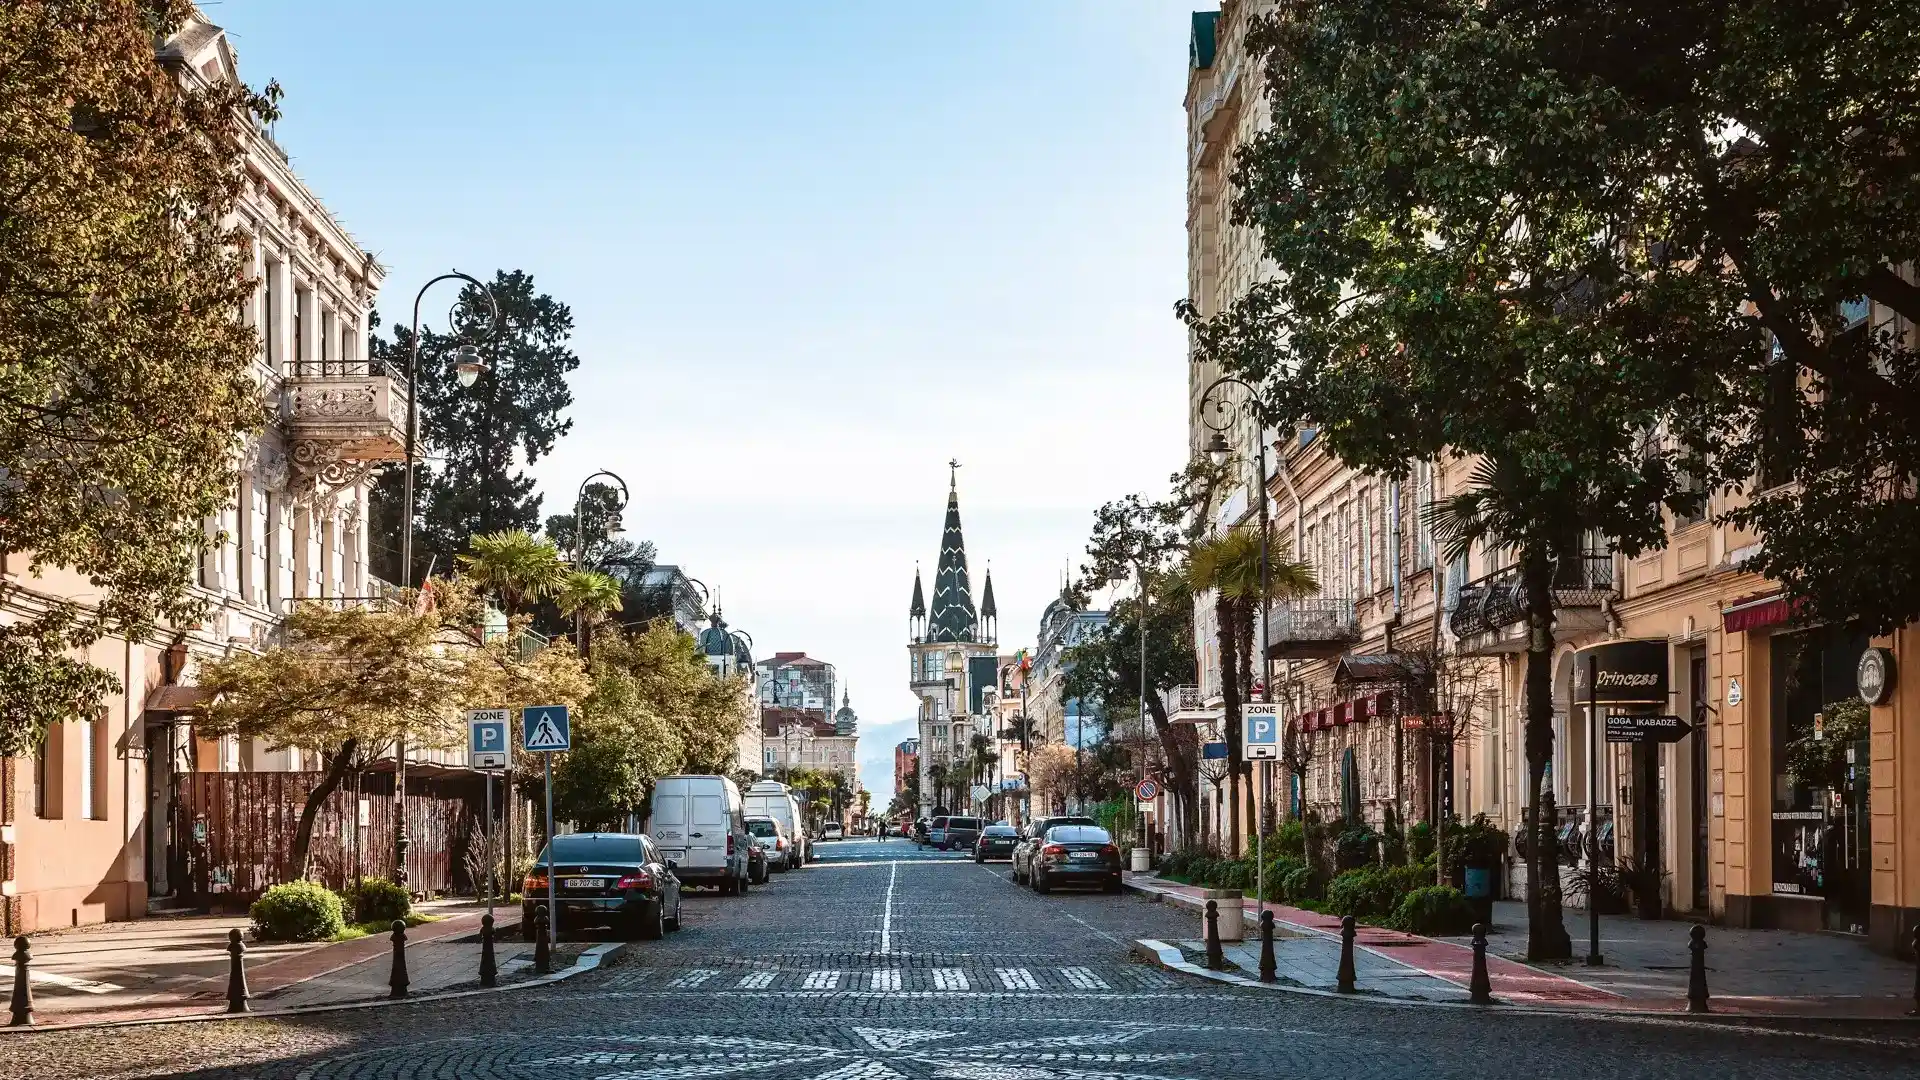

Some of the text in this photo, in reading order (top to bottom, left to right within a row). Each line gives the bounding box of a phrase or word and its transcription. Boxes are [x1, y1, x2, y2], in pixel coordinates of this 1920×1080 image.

[1596, 671, 1658, 688] Princess
[474, 712, 504, 720] ZONE
[1248, 706, 1276, 714] ZONE
[1607, 717, 1631, 725] GOGA
[1636, 719, 1677, 727] IKABADZE
[1256, 721, 1269, 739] P
[482, 728, 497, 747] P
